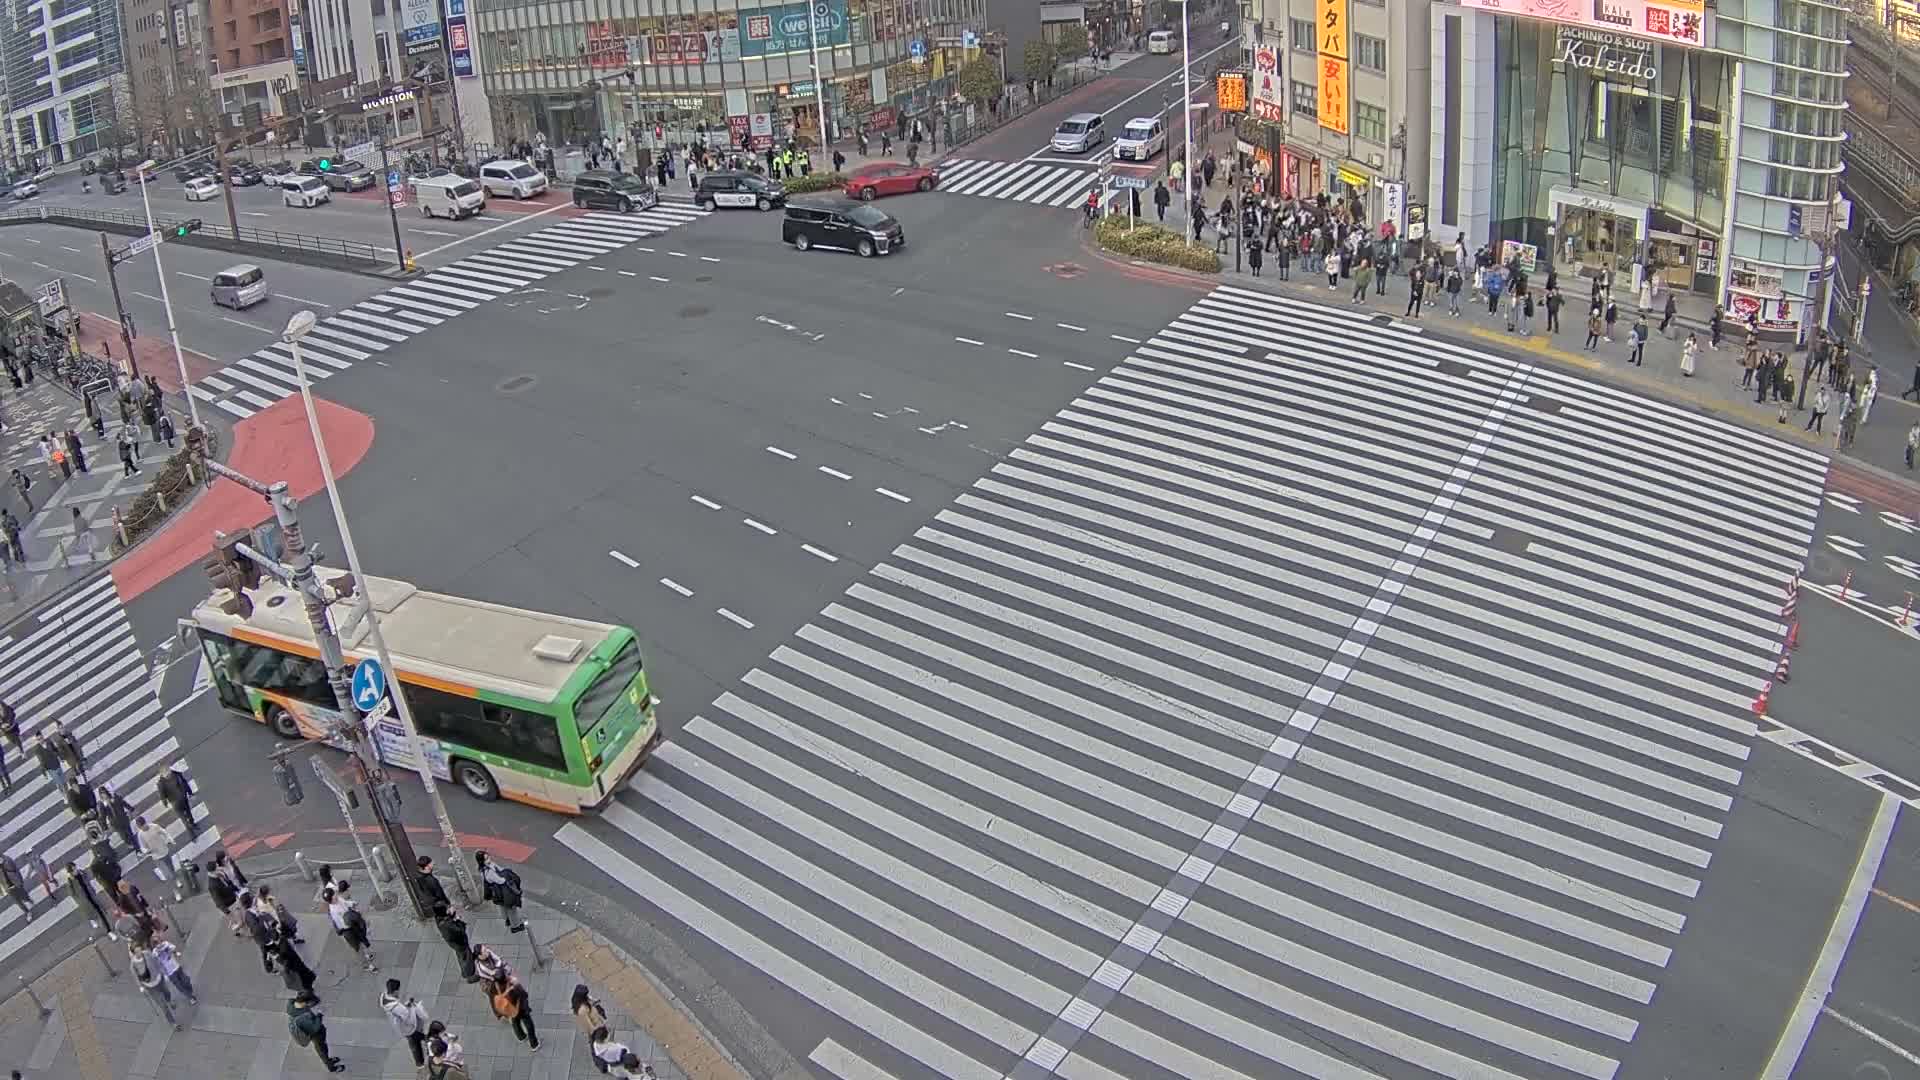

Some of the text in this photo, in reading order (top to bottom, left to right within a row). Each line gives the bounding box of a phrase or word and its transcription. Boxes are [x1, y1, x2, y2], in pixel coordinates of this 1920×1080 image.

[1556, 26, 1652, 51] PACHINKO & SLOT
[1551, 38, 1658, 80] Kaleido
